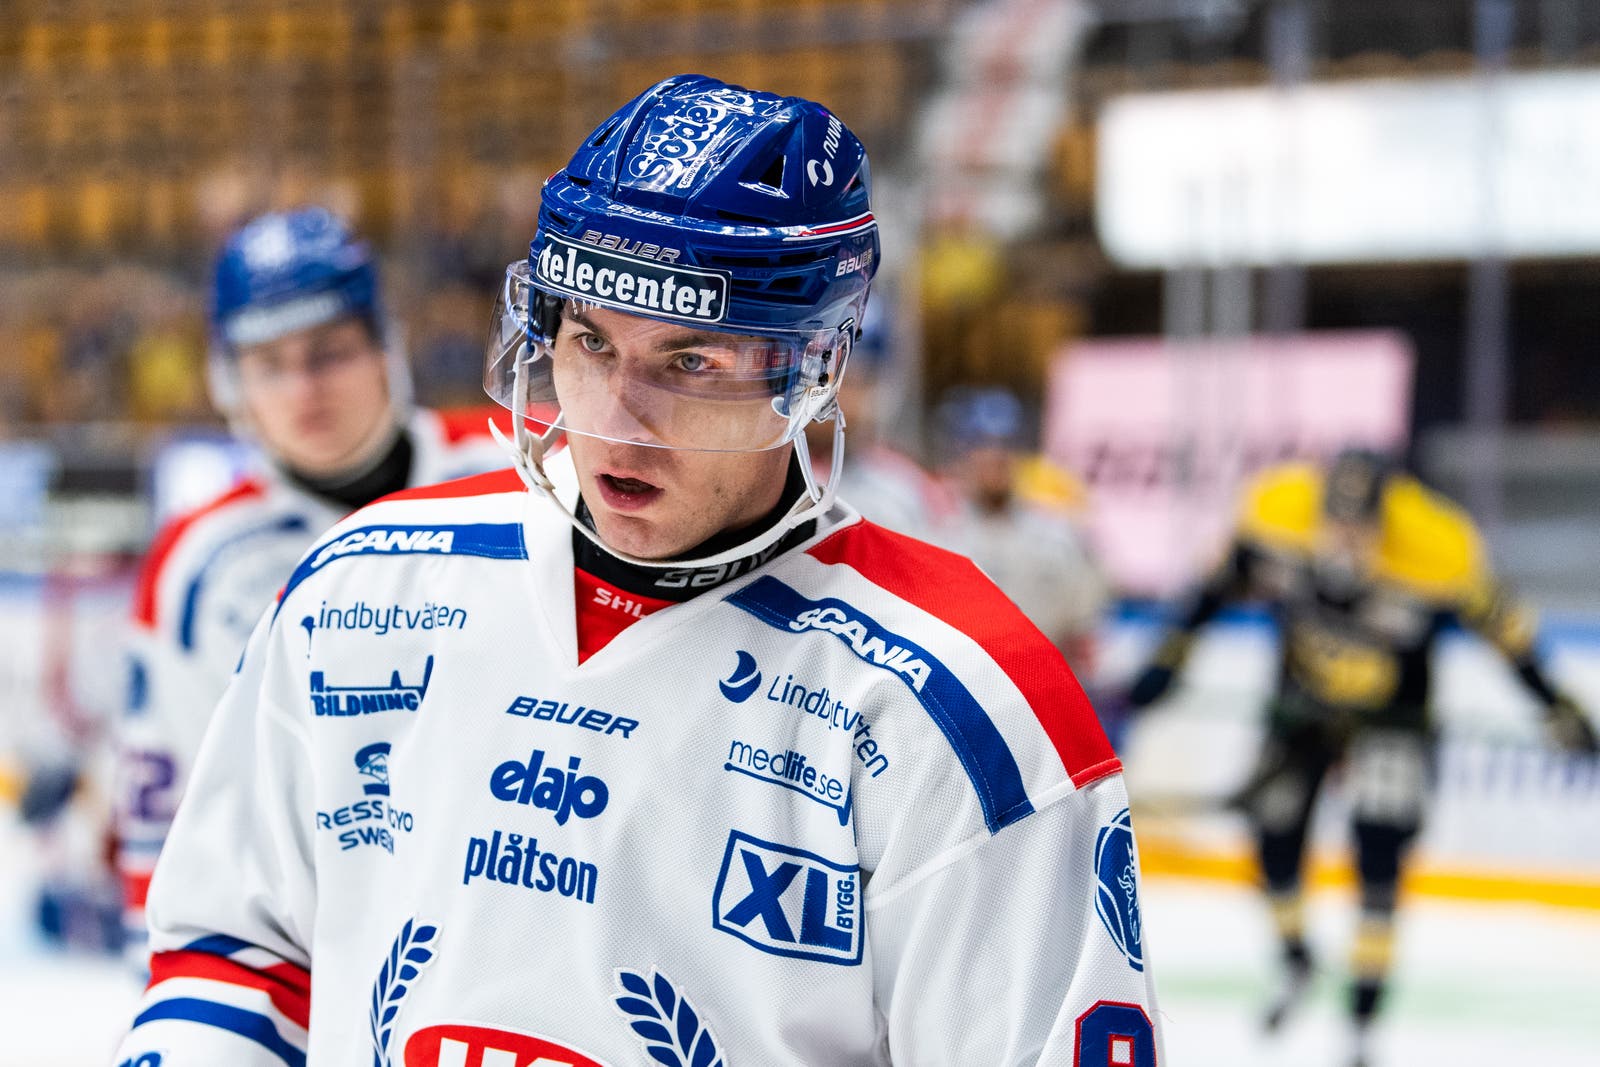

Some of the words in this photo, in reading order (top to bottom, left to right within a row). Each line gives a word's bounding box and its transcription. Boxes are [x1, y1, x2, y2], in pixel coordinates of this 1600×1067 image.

[580, 229, 681, 264] BAUER
[606, 204, 675, 224] BAUER
[541, 243, 717, 317] telecenter
[310, 530, 454, 568] SCANIA
[789, 607, 932, 693] SCANIA
[506, 696, 640, 739] BAUER
[490, 749, 609, 826] elajo
[728, 739, 844, 800] medlife.se
[463, 831, 598, 904] plåtson
[722, 848, 853, 953] XL
